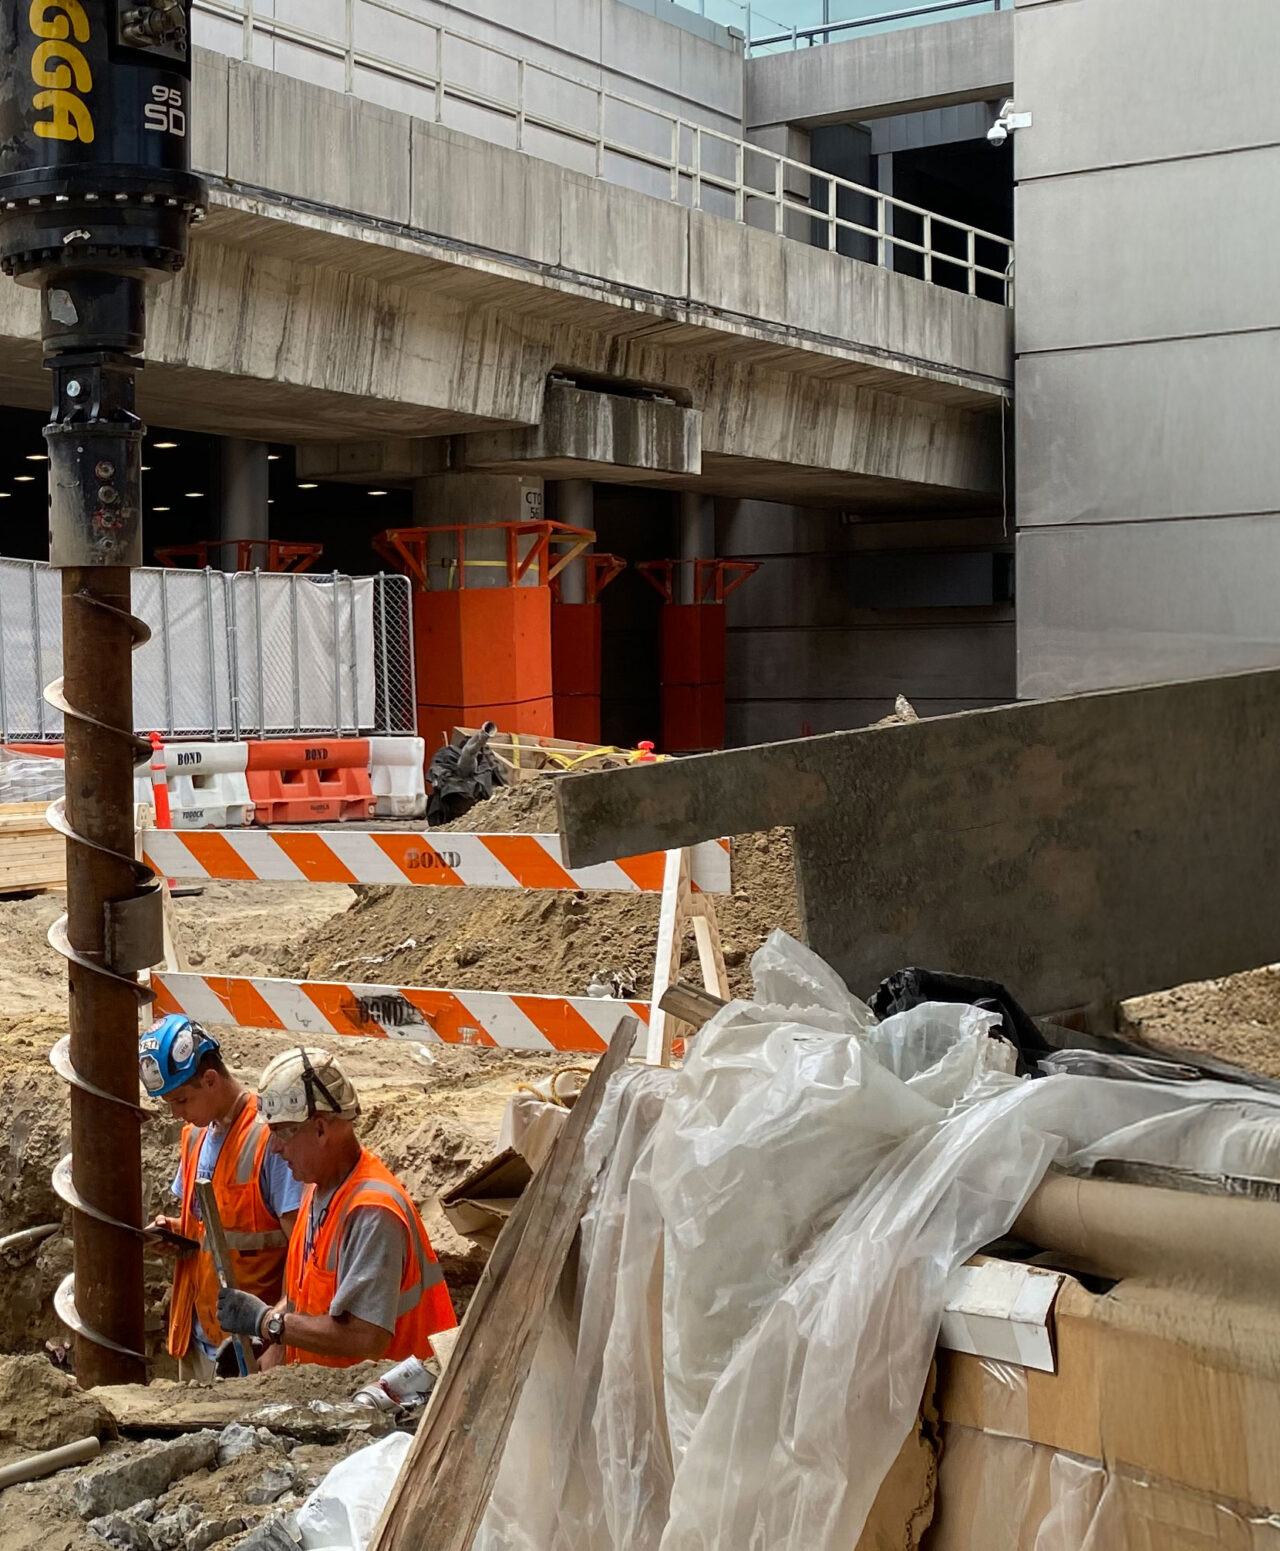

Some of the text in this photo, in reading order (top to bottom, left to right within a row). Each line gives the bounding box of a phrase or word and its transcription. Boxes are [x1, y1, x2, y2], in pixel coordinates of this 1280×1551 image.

[151, 85, 182, 107] 95
[144, 103, 186, 137] SD
[525, 491, 542, 505] CTO
[177, 751, 202, 766] BOND
[305, 748, 328, 761] BOND
[406, 851, 461, 869] BOND
[359, 997, 406, 1027] BOND
